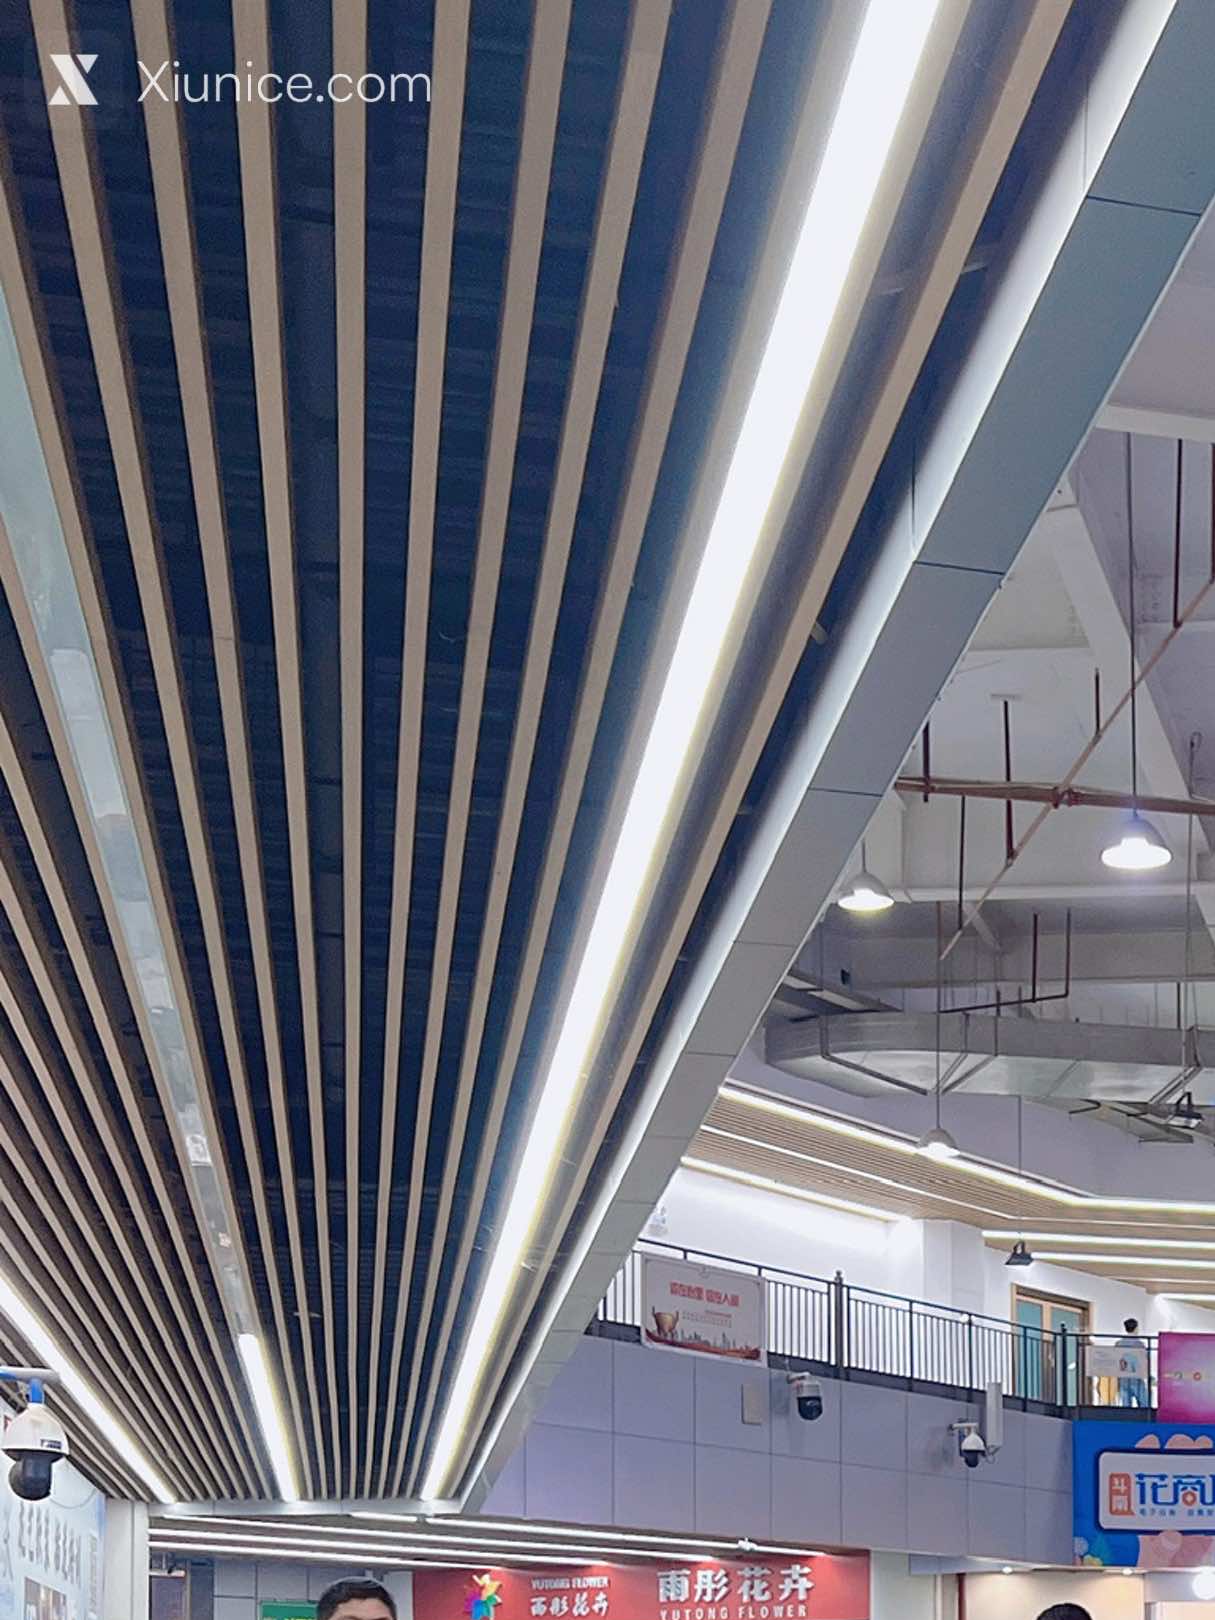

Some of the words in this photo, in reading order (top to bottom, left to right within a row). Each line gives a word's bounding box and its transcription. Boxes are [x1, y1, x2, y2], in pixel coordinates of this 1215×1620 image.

[656, 1564, 815, 1603] 雨彤花卉
[738, 1604, 807, 1619] FLOWER
